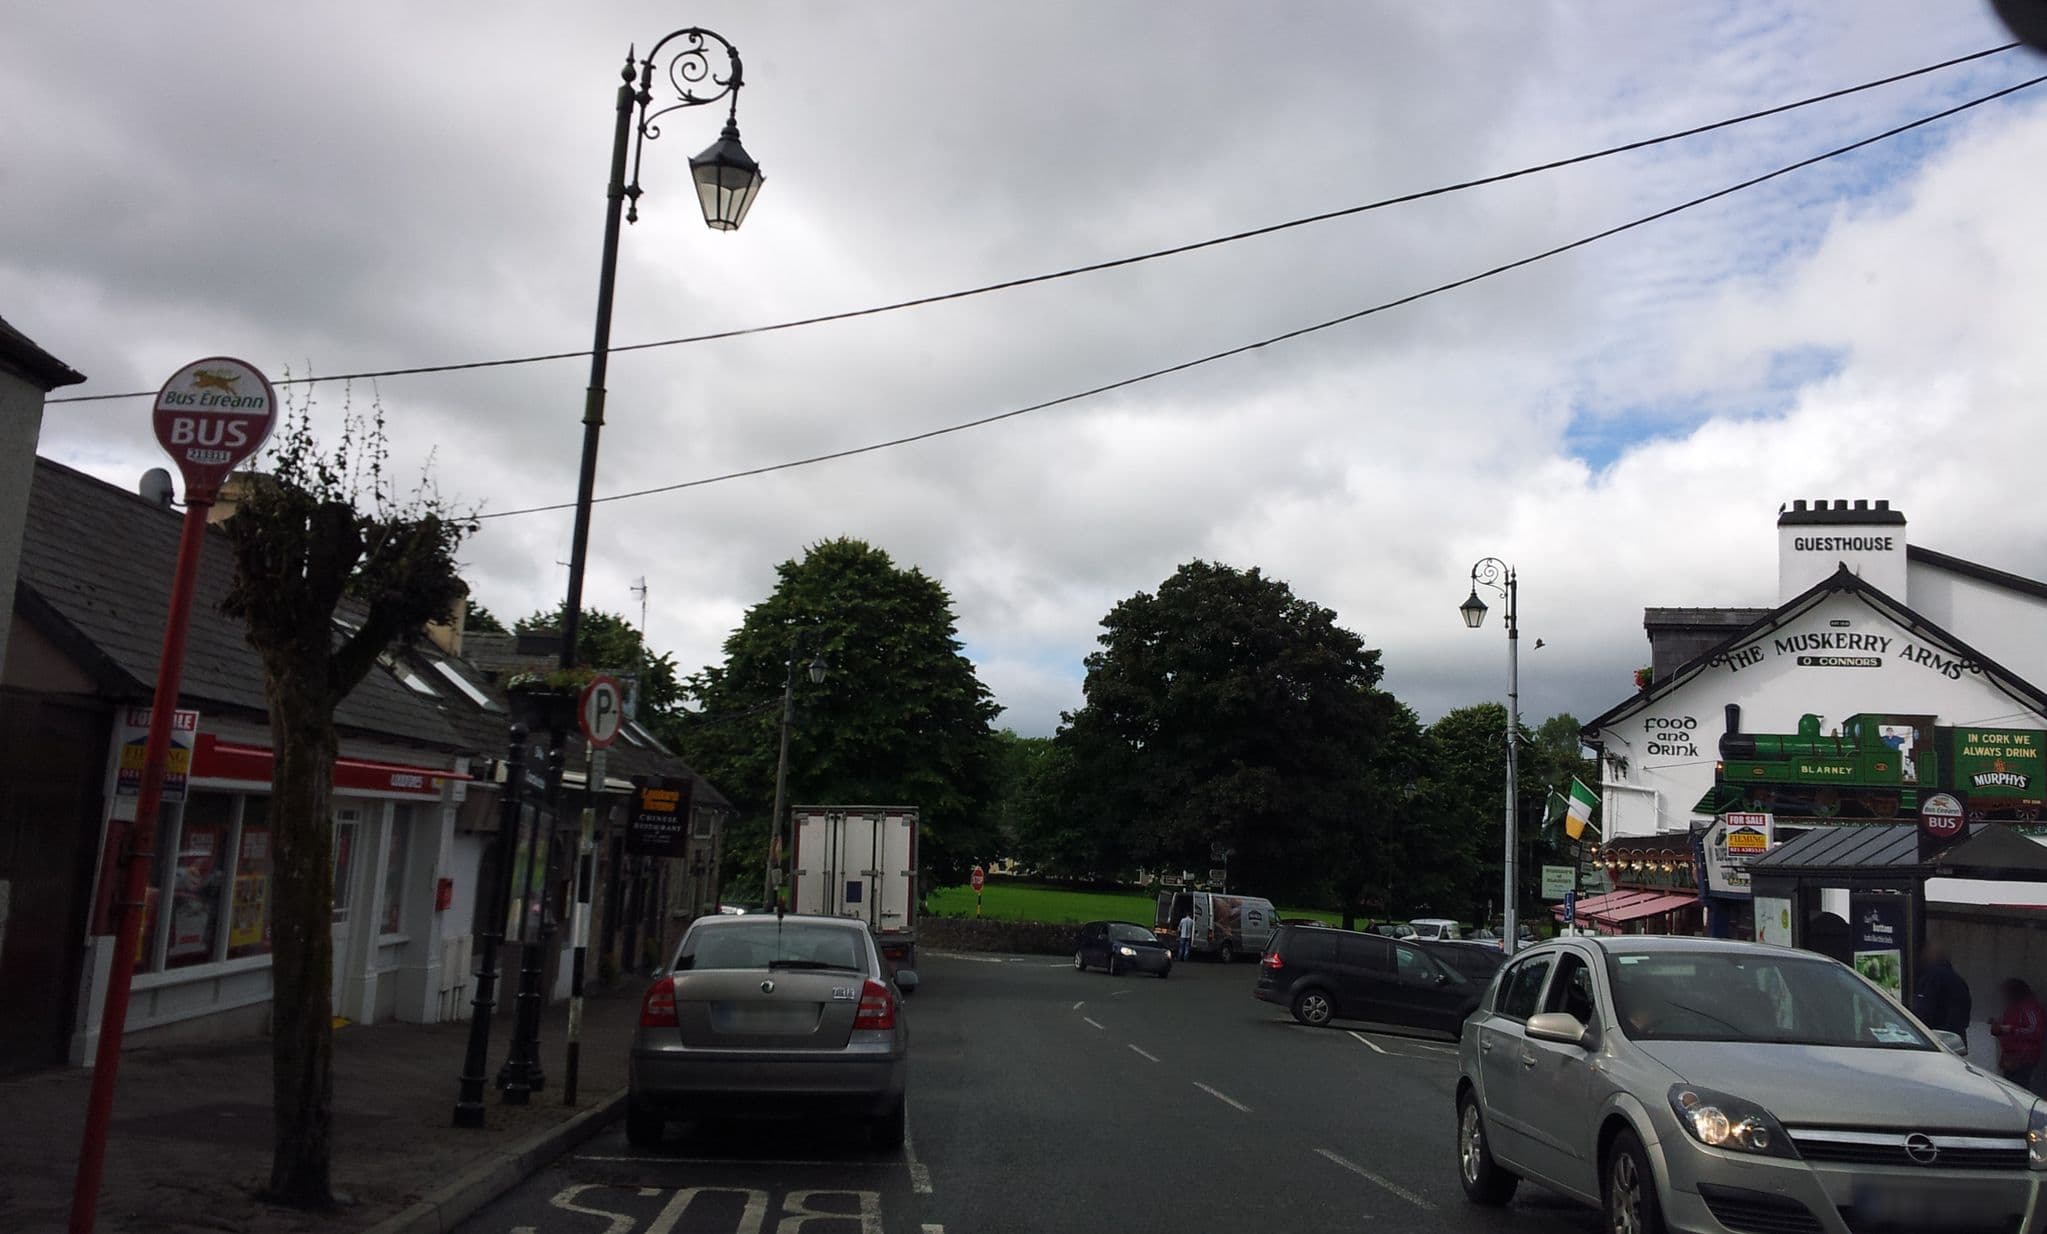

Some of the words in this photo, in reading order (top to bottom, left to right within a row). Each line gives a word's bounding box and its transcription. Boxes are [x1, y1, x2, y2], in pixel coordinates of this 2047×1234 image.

[164, 391, 196, 405] Bus
[170, 417, 249, 447] BUS
[1794, 537, 1893, 552] GUESTHOUSE
[1726, 646, 1765, 673] THE
[1774, 632, 1893, 656] MUSKERRY
[1899, 643, 1964, 681] ARMS
[1803, 657, 1812, 666] O
[1819, 657, 1878, 667] CONNORS
[1968, 733, 1978, 743] IN
[1982, 733, 2010, 744] CORK
[2014, 735, 2030, 745] WE
[1963, 746, 2001, 757] ALWAYS
[2006, 748, 2037, 759] DRINK
[1801, 765, 1853, 775] BLARNEY
[1729, 815, 1744, 825] FOR
[1745, 815, 1764, 825] SALE
[1928, 816, 1956, 829] BUS
